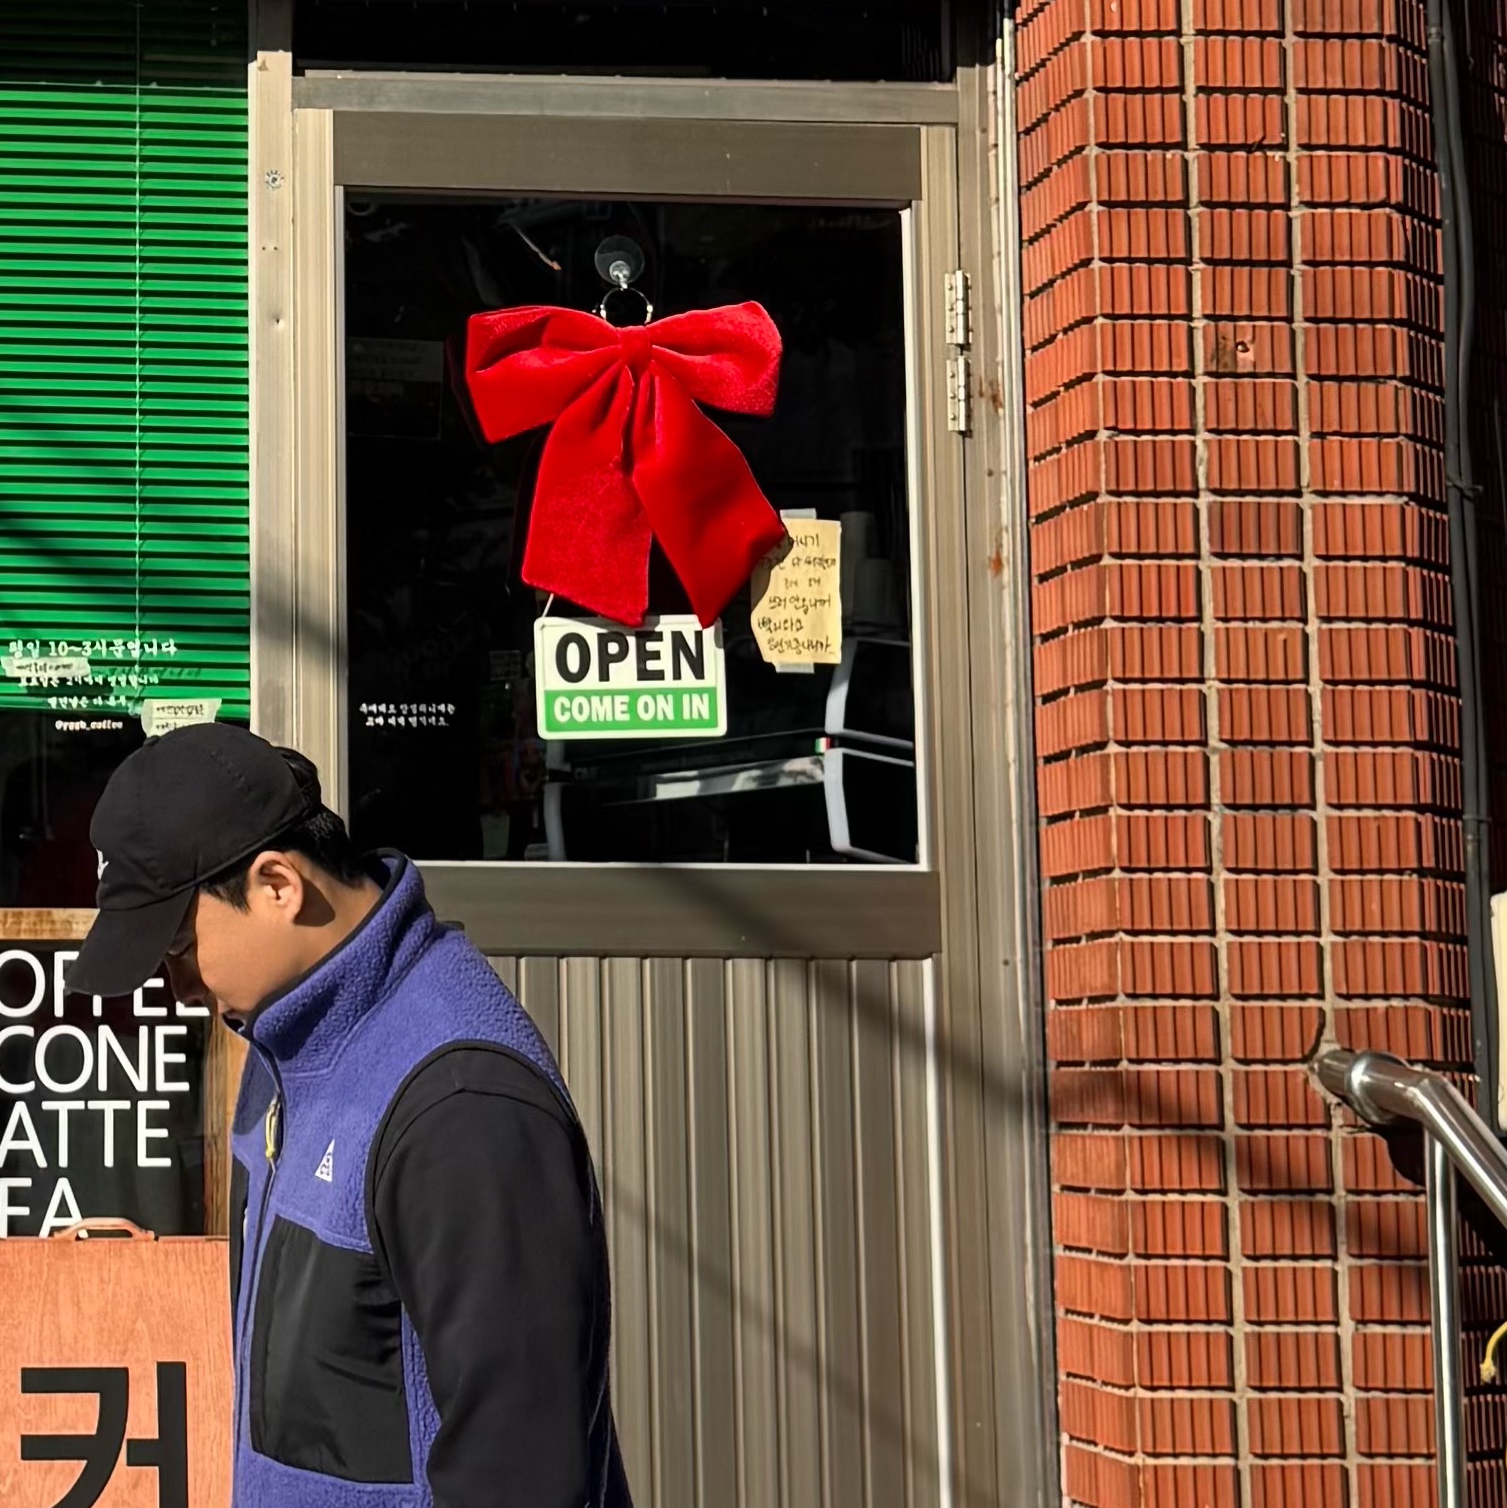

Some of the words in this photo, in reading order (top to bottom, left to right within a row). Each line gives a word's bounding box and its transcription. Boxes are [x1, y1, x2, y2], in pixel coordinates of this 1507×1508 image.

[556, 631, 705, 683] OPEN
[554, 695, 630, 723] COME
[637, 694, 674, 721] ON
[682, 693, 710, 720] IN
